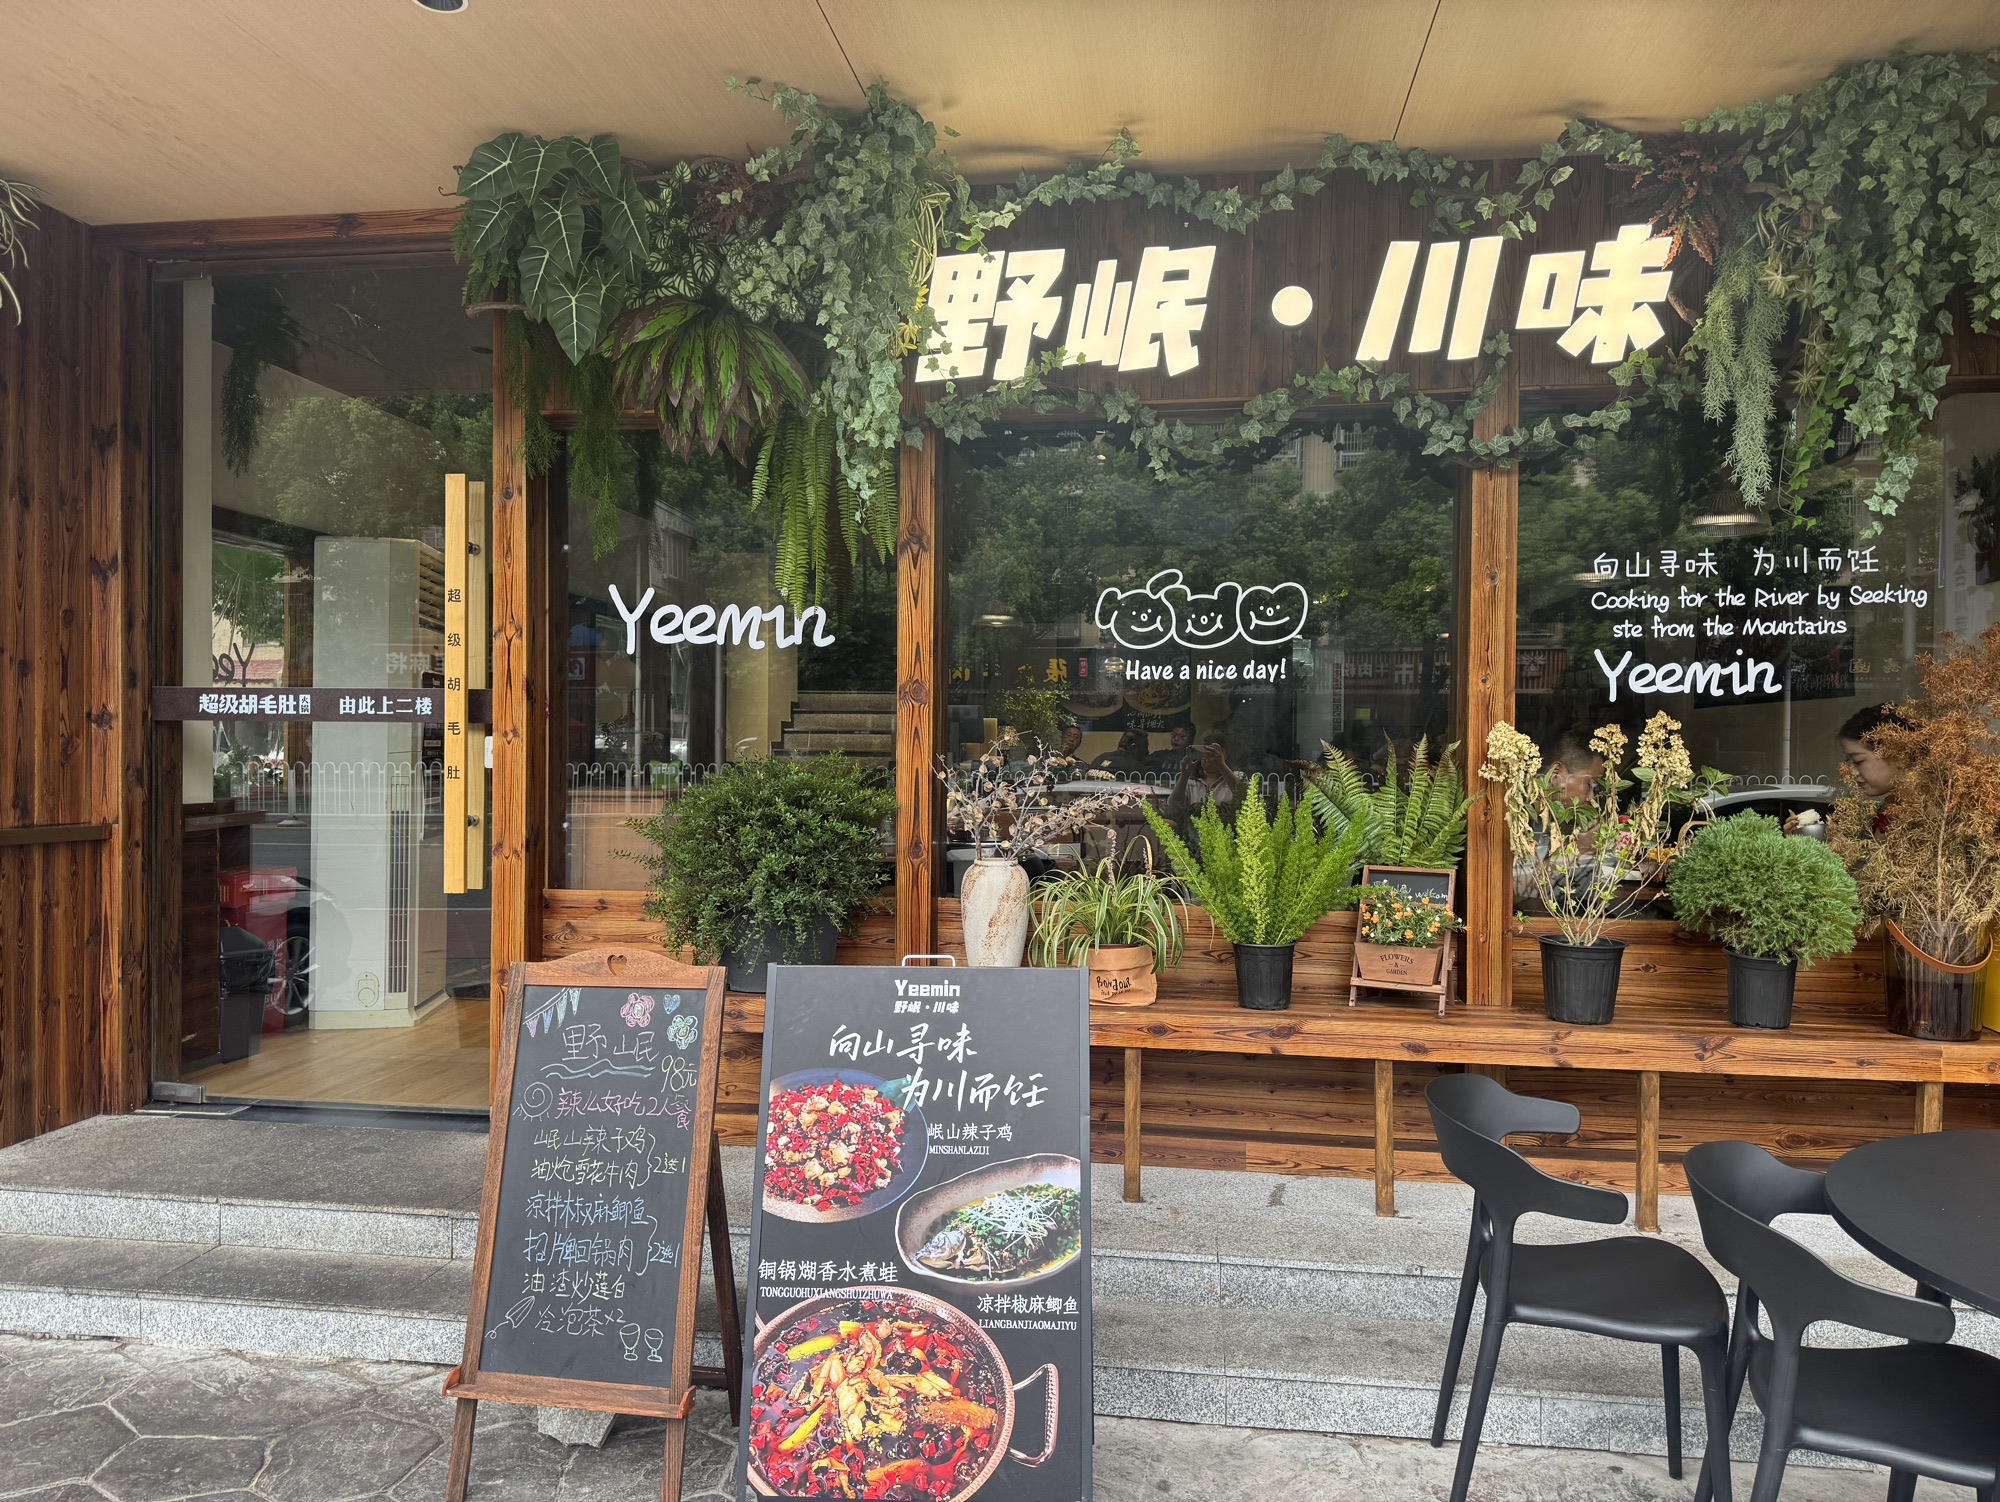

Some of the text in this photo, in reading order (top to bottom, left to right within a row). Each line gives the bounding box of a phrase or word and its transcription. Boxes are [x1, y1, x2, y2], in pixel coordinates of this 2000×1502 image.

[1593, 545, 1879, 579] 向山寻味 为川而饪
[1591, 582, 1929, 613] Cooking for the River by Seeking
[608, 583, 836, 655] Yeemin
[1612, 614, 1848, 639] ste from the Mountains
[1125, 659, 1174, 681] Have
[1179, 664, 1190, 680] a
[1196, 659, 1238, 680] nice
[1242, 657, 1287, 683] day!
[1593, 648, 1782, 702] Yeemin
[339, 696, 433, 715] 由此上二楼
[1380, 954, 1415, 965] FLOWERS
[1386, 968, 1408, 976] GARDEN
[894, 979, 961, 997] Yeemin
[561, 1024, 660, 1062] 野岷
[829, 1022, 978, 1065] 向山寻味
[660, 1054, 698, 1094] 98元
[901, 1066, 1049, 1112] 为川而饪
[533, 1124, 646, 1157] 岷山辣子鸡
[928, 1122, 1013, 1142] 岷山辣子鸡
[929, 1145, 990, 1155] MINSHANLAZIJI
[522, 1229, 634, 1272] 招牌回锅肉
[522, 1267, 626, 1305] 油渣炒莲白
[760, 1286, 894, 1300] TONGGUOHUXIANGSHUIZHUWA
[976, 1293, 1080, 1315] 凉拌椒麻鲫鱼
[978, 1319, 1078, 1331] LIANGBANJIAOMAJIYU
